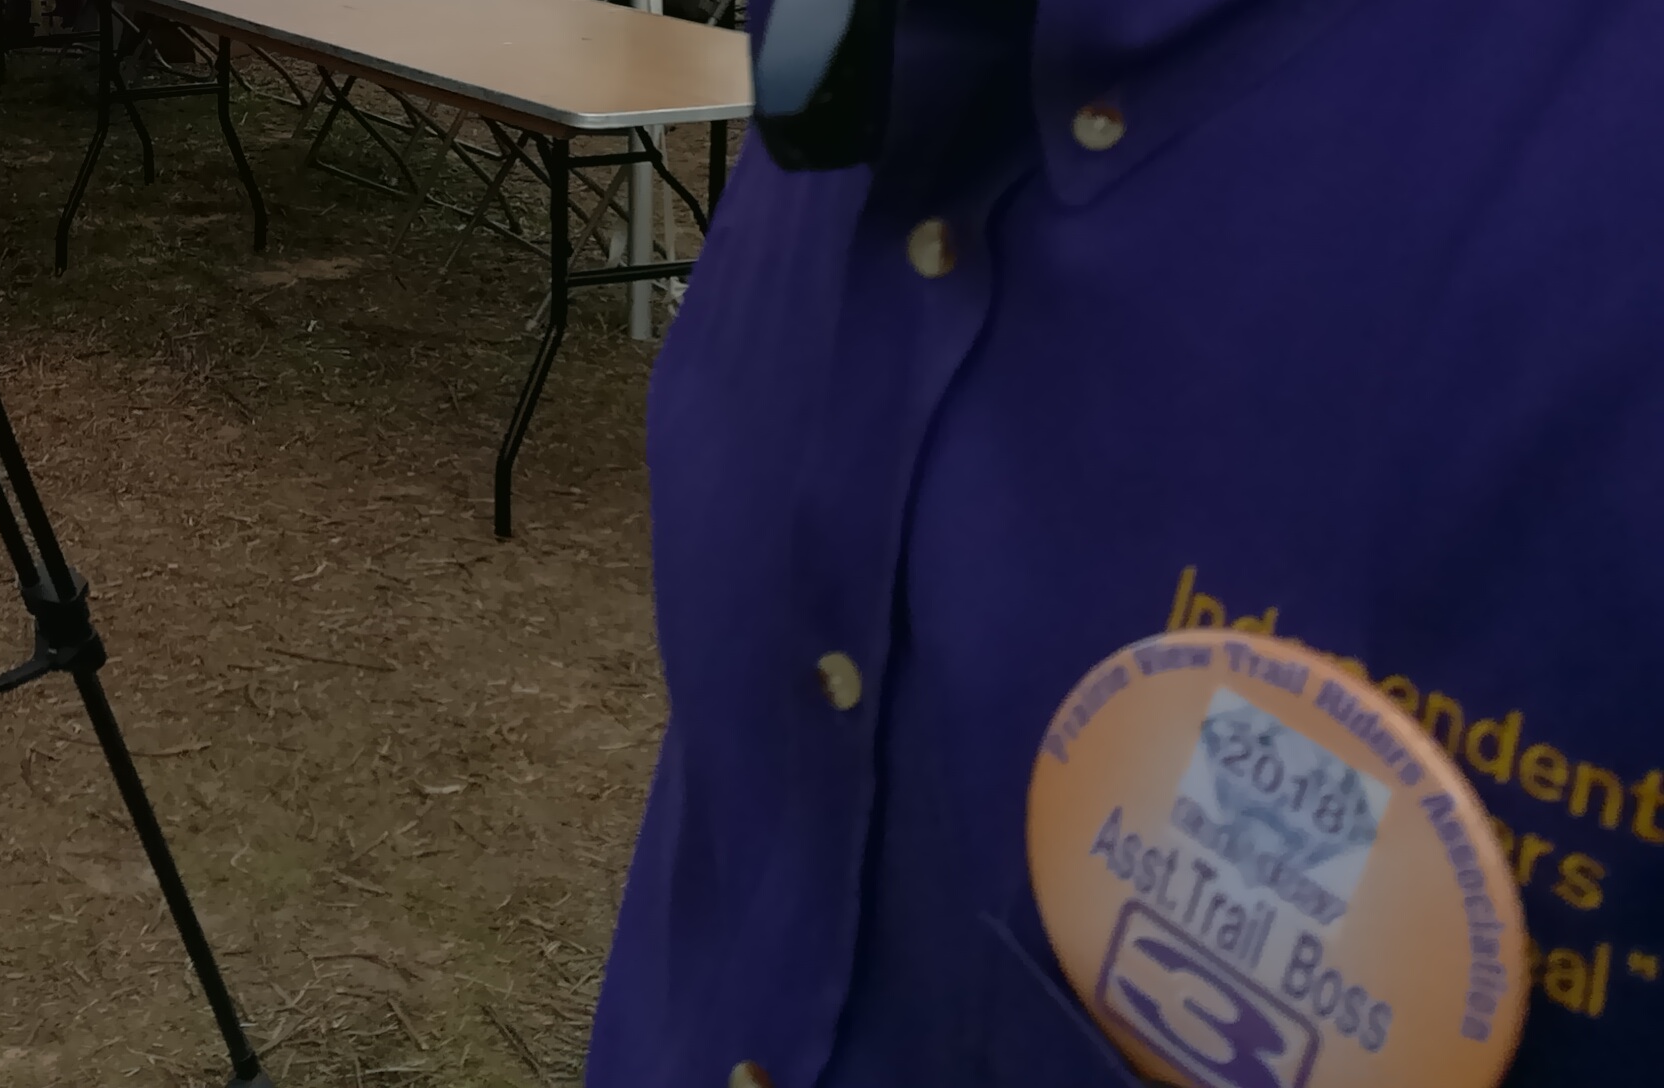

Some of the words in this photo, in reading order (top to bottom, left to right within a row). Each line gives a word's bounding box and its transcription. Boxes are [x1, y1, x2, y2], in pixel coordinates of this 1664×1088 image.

[1220, 733, 1346, 834] 2018
[1224, 641, 1309, 695] Trail
[1314, 680, 1424, 786] Riders
[1420, 792, 1507, 1043] Association
[1281, 933, 1392, 1053] Boss
